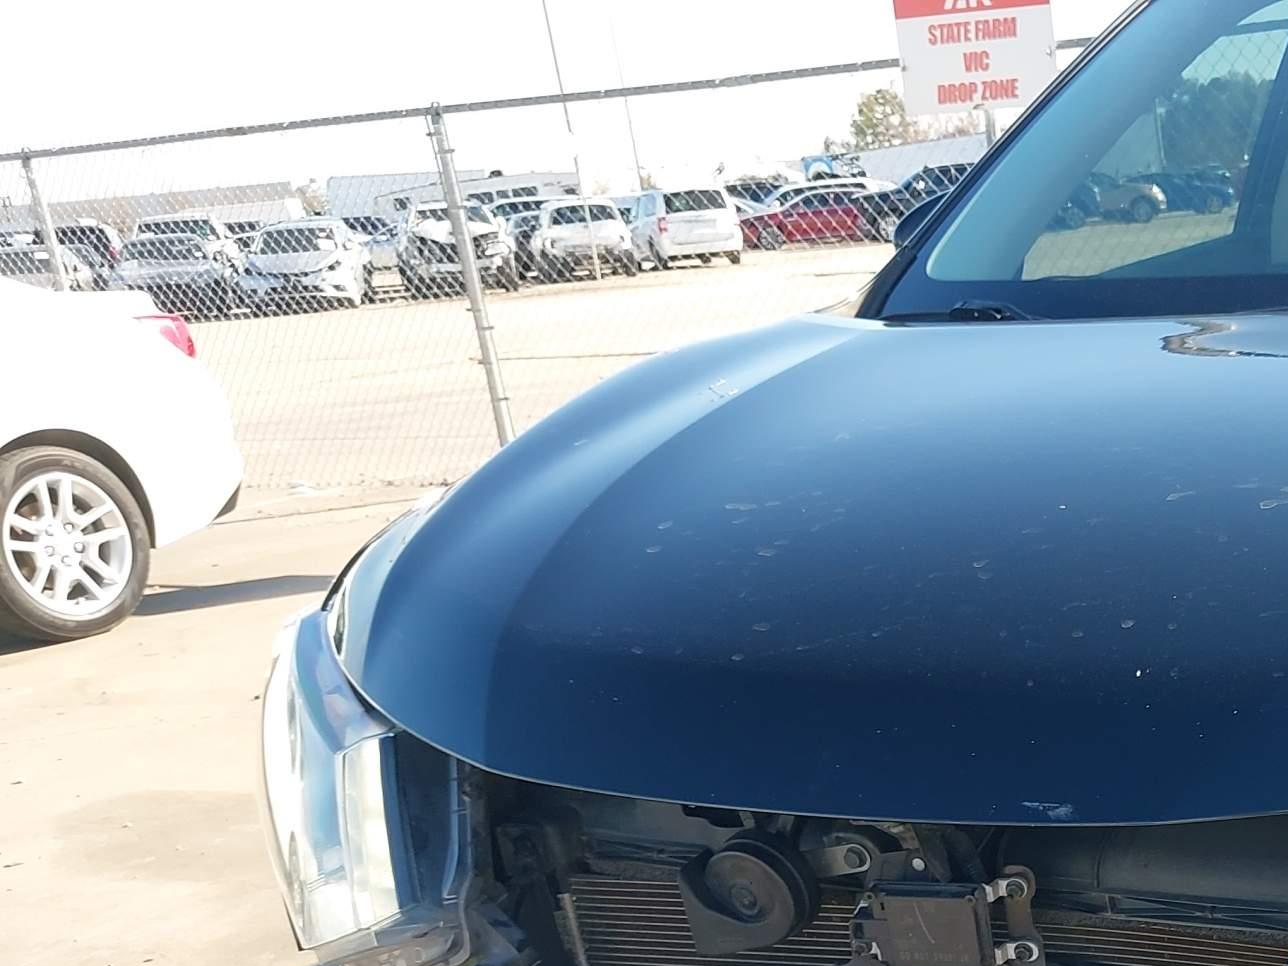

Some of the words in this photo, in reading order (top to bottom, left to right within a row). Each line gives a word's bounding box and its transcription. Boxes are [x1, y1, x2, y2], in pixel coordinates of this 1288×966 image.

[928, 21, 972, 46] STATE
[974, 16, 1018, 41] FARM
[963, 50, 991, 73] VIC
[937, 81, 978, 105] DROP
[980, 78, 1019, 102] ZONE
